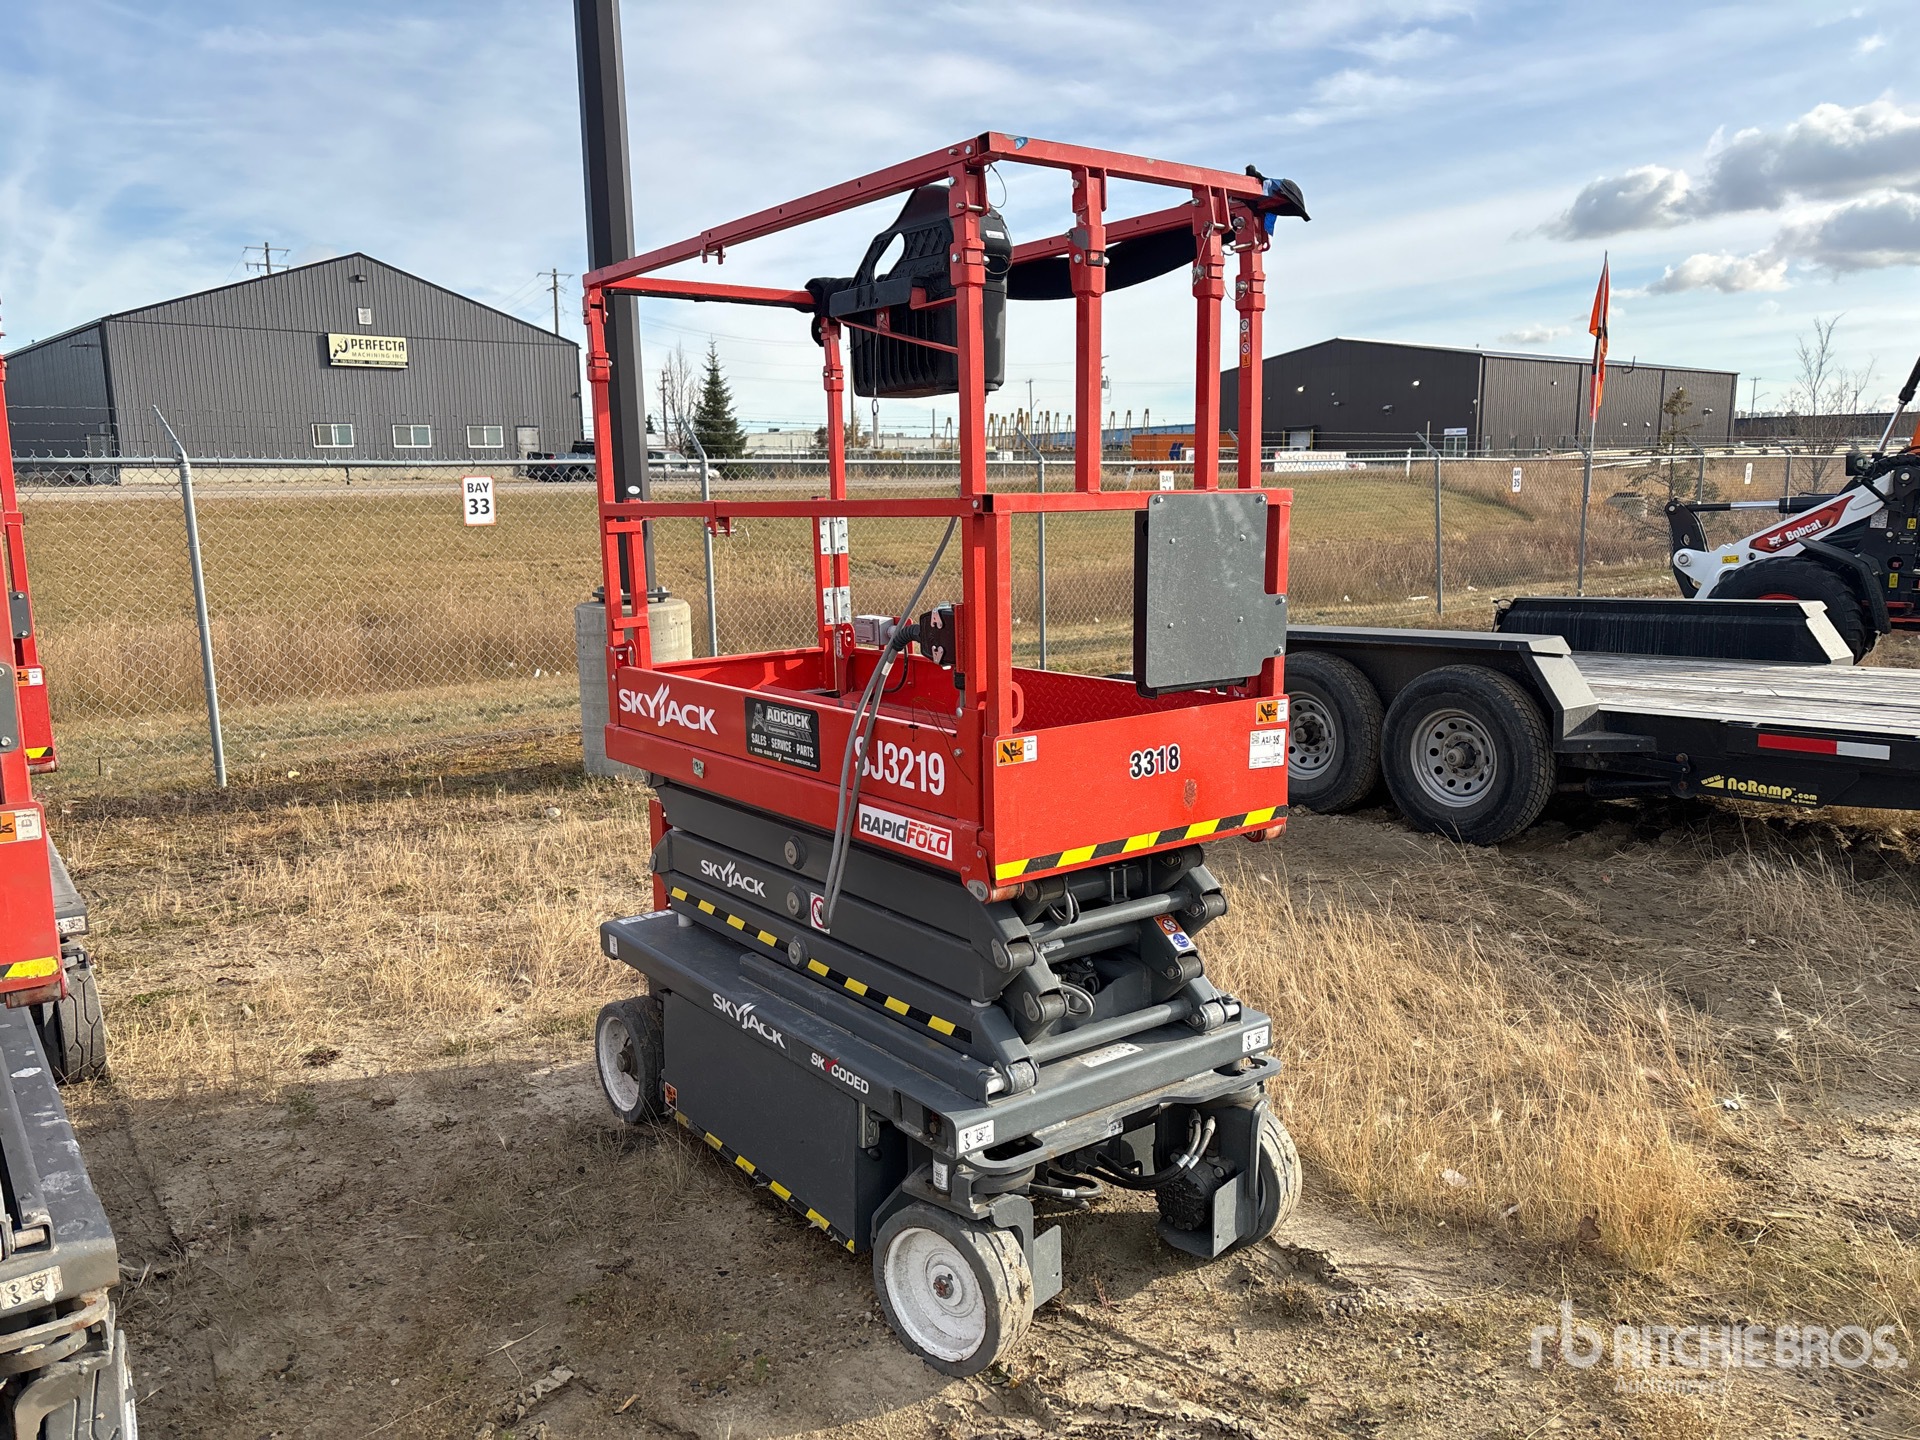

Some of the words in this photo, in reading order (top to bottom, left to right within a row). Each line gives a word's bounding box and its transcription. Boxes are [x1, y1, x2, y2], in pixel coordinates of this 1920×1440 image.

[351, 339, 405, 351] PERFECTA
[467, 482, 489, 493] BAY
[469, 498, 490, 515] 33
[1785, 519, 1822, 542] Bobcat
[618, 683, 719, 735] SKYJACK
[766, 708, 810, 729] ADCOCK
[751, 733, 767, 746] SALES
[771, 738, 792, 753] SERVICE
[796, 744, 814, 758] PARTS
[854, 736, 945, 796] SJ3219
[1130, 743, 1180, 779] 3318
[700, 860, 767, 898] SKYJACK
[712, 992, 786, 1050] SKYJACK
[811, 1052, 869, 1095] SKYCODED
